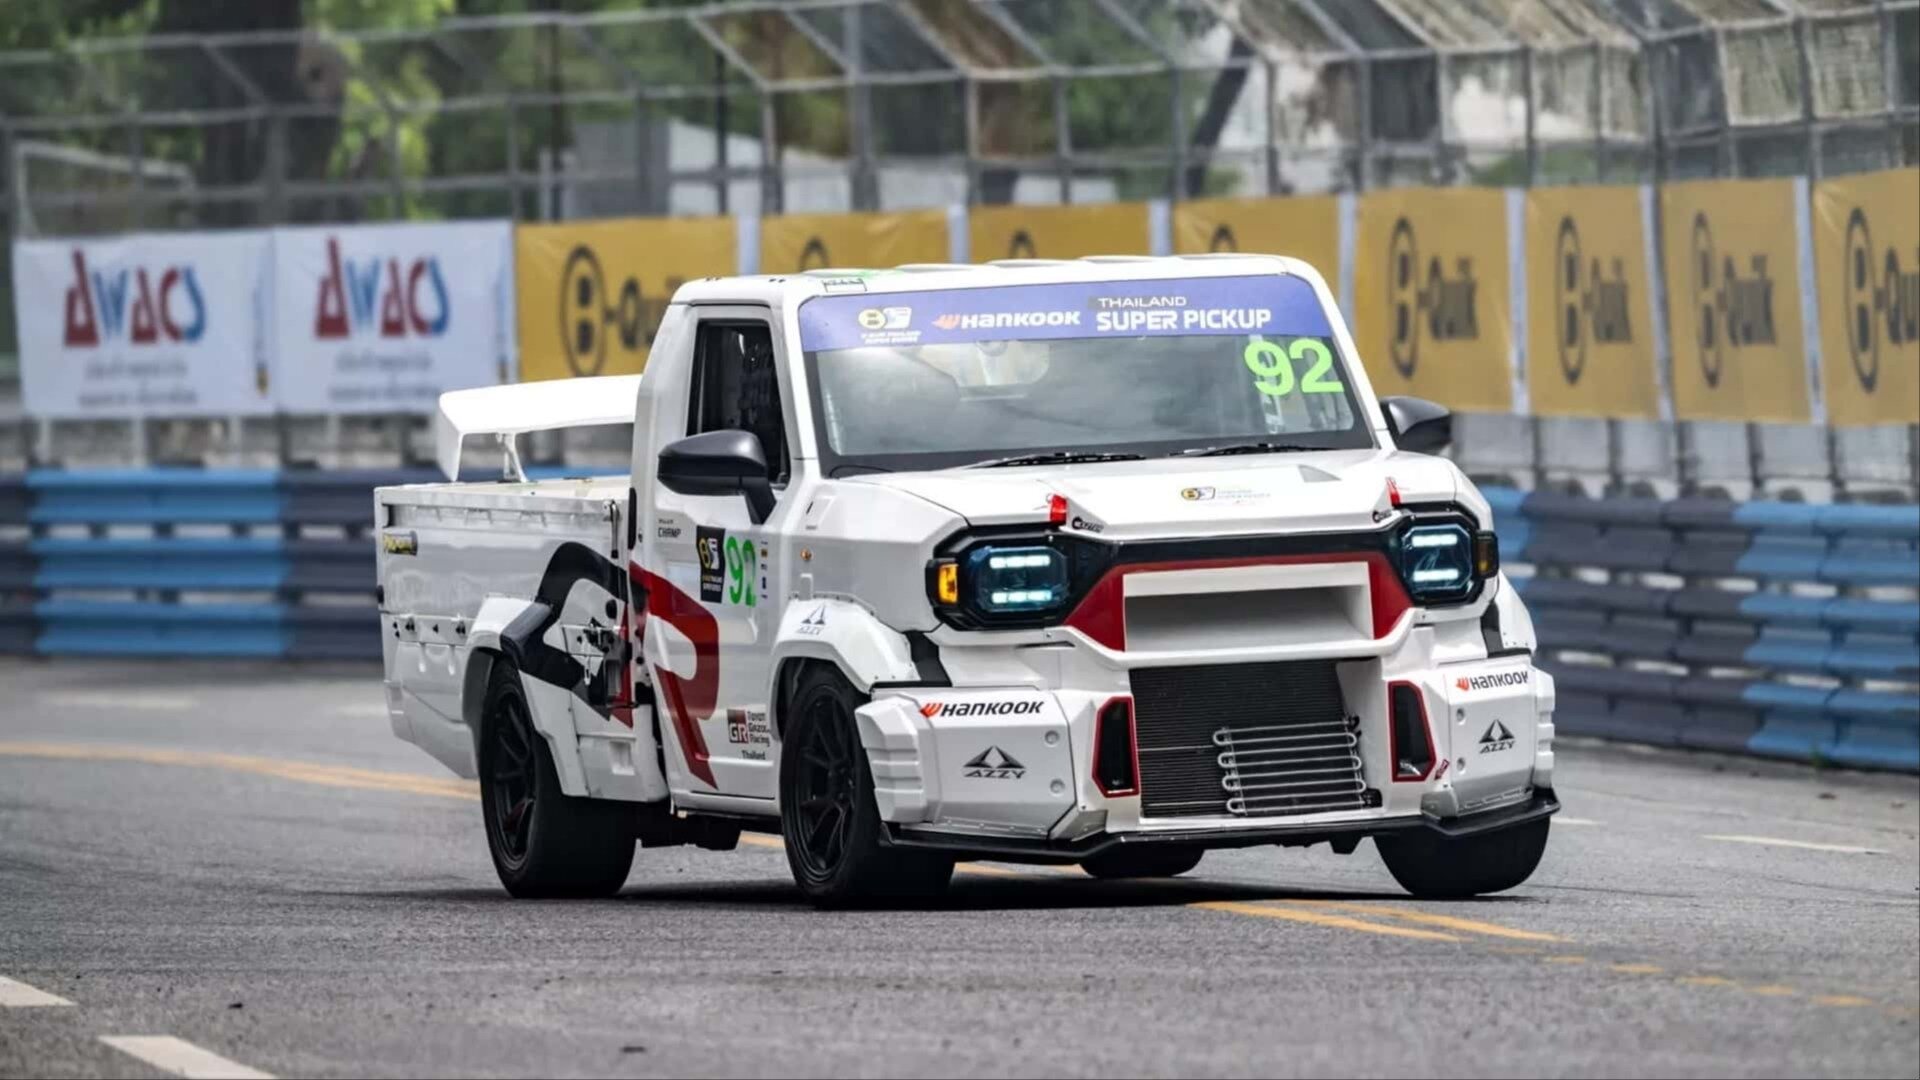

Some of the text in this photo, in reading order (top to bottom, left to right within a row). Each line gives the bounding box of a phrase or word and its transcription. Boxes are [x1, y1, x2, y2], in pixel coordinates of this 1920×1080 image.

[1098, 296, 1187, 308] THAILAND
[1096, 308, 1272, 331] SUPER PICKUP
[1244, 338, 1345, 396] 92
[726, 536, 756, 607] 92
[730, 723, 748, 742] GR
[1479, 740, 1515, 754] AZZY
[964, 769, 1027, 780] AZZY
